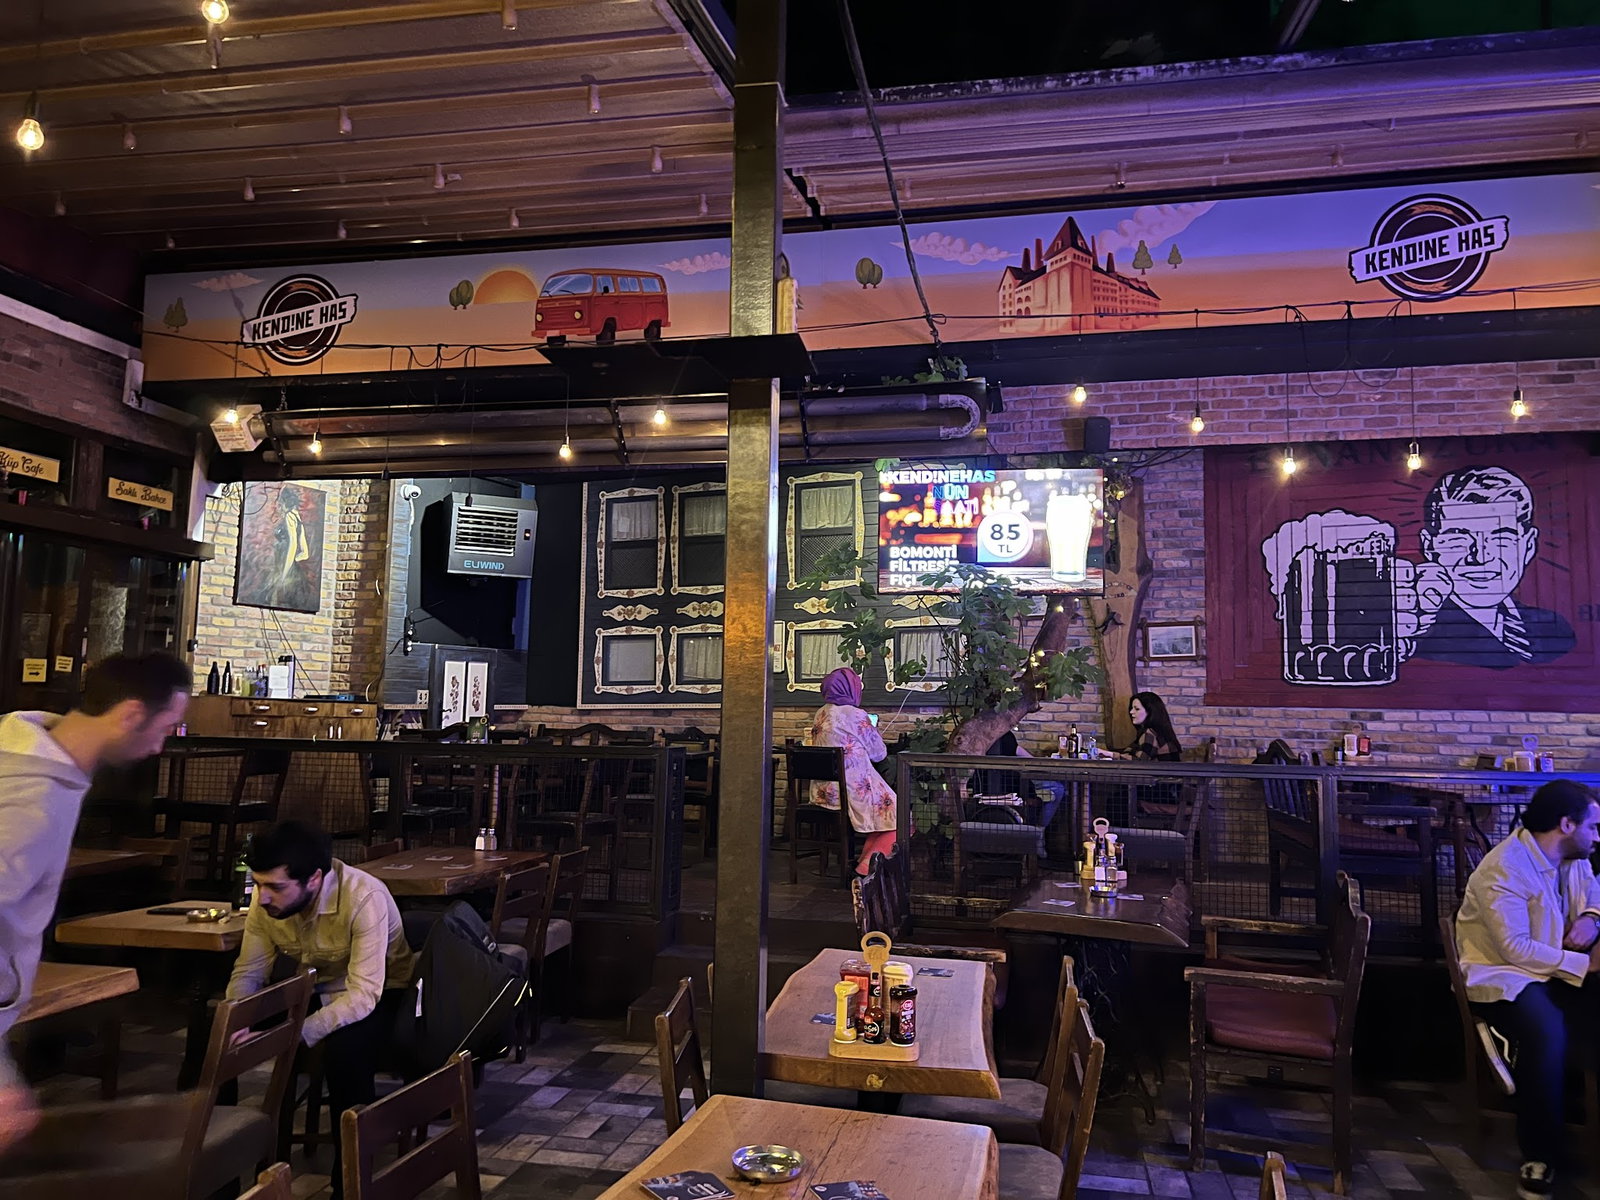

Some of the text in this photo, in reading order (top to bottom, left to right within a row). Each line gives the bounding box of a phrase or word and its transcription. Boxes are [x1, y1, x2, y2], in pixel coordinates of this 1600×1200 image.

[1457, 224, 1495, 252] HAS
[320, 301, 348, 324] HAS
[21, 456, 44, 476] Cafe
[990, 523, 1021, 541] 85
[889, 544, 957, 559] BOMONTİ
[998, 544, 1013, 553] TL
